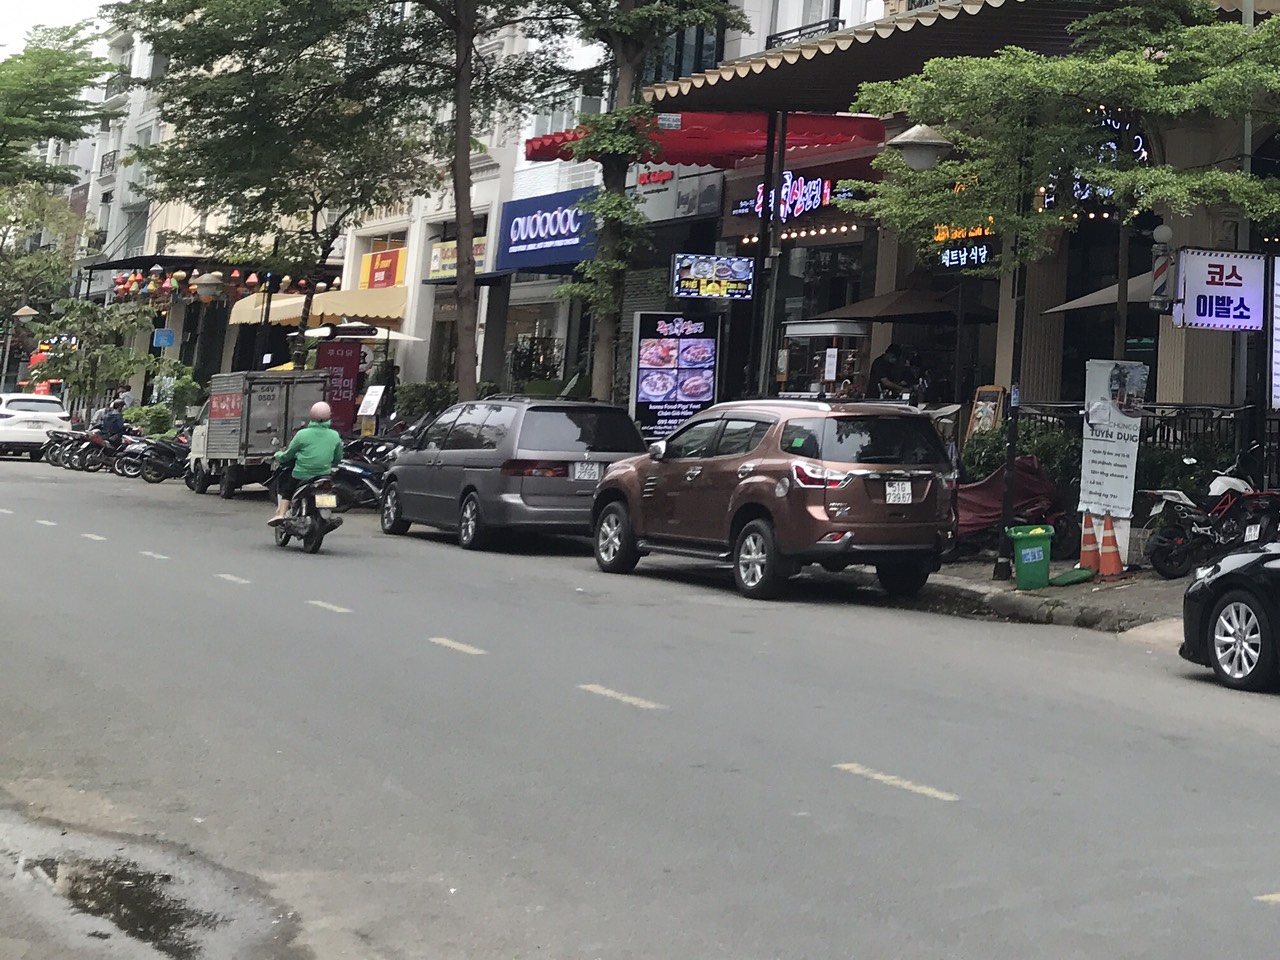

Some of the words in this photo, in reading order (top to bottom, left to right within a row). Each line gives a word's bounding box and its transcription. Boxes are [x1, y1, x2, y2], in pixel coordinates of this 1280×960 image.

[969, 244, 988, 265] 식당
[1205, 263, 1243, 287] 코스
[1196, 294, 1251, 320] 이발소
[891, 482, 906, 493] 51G
